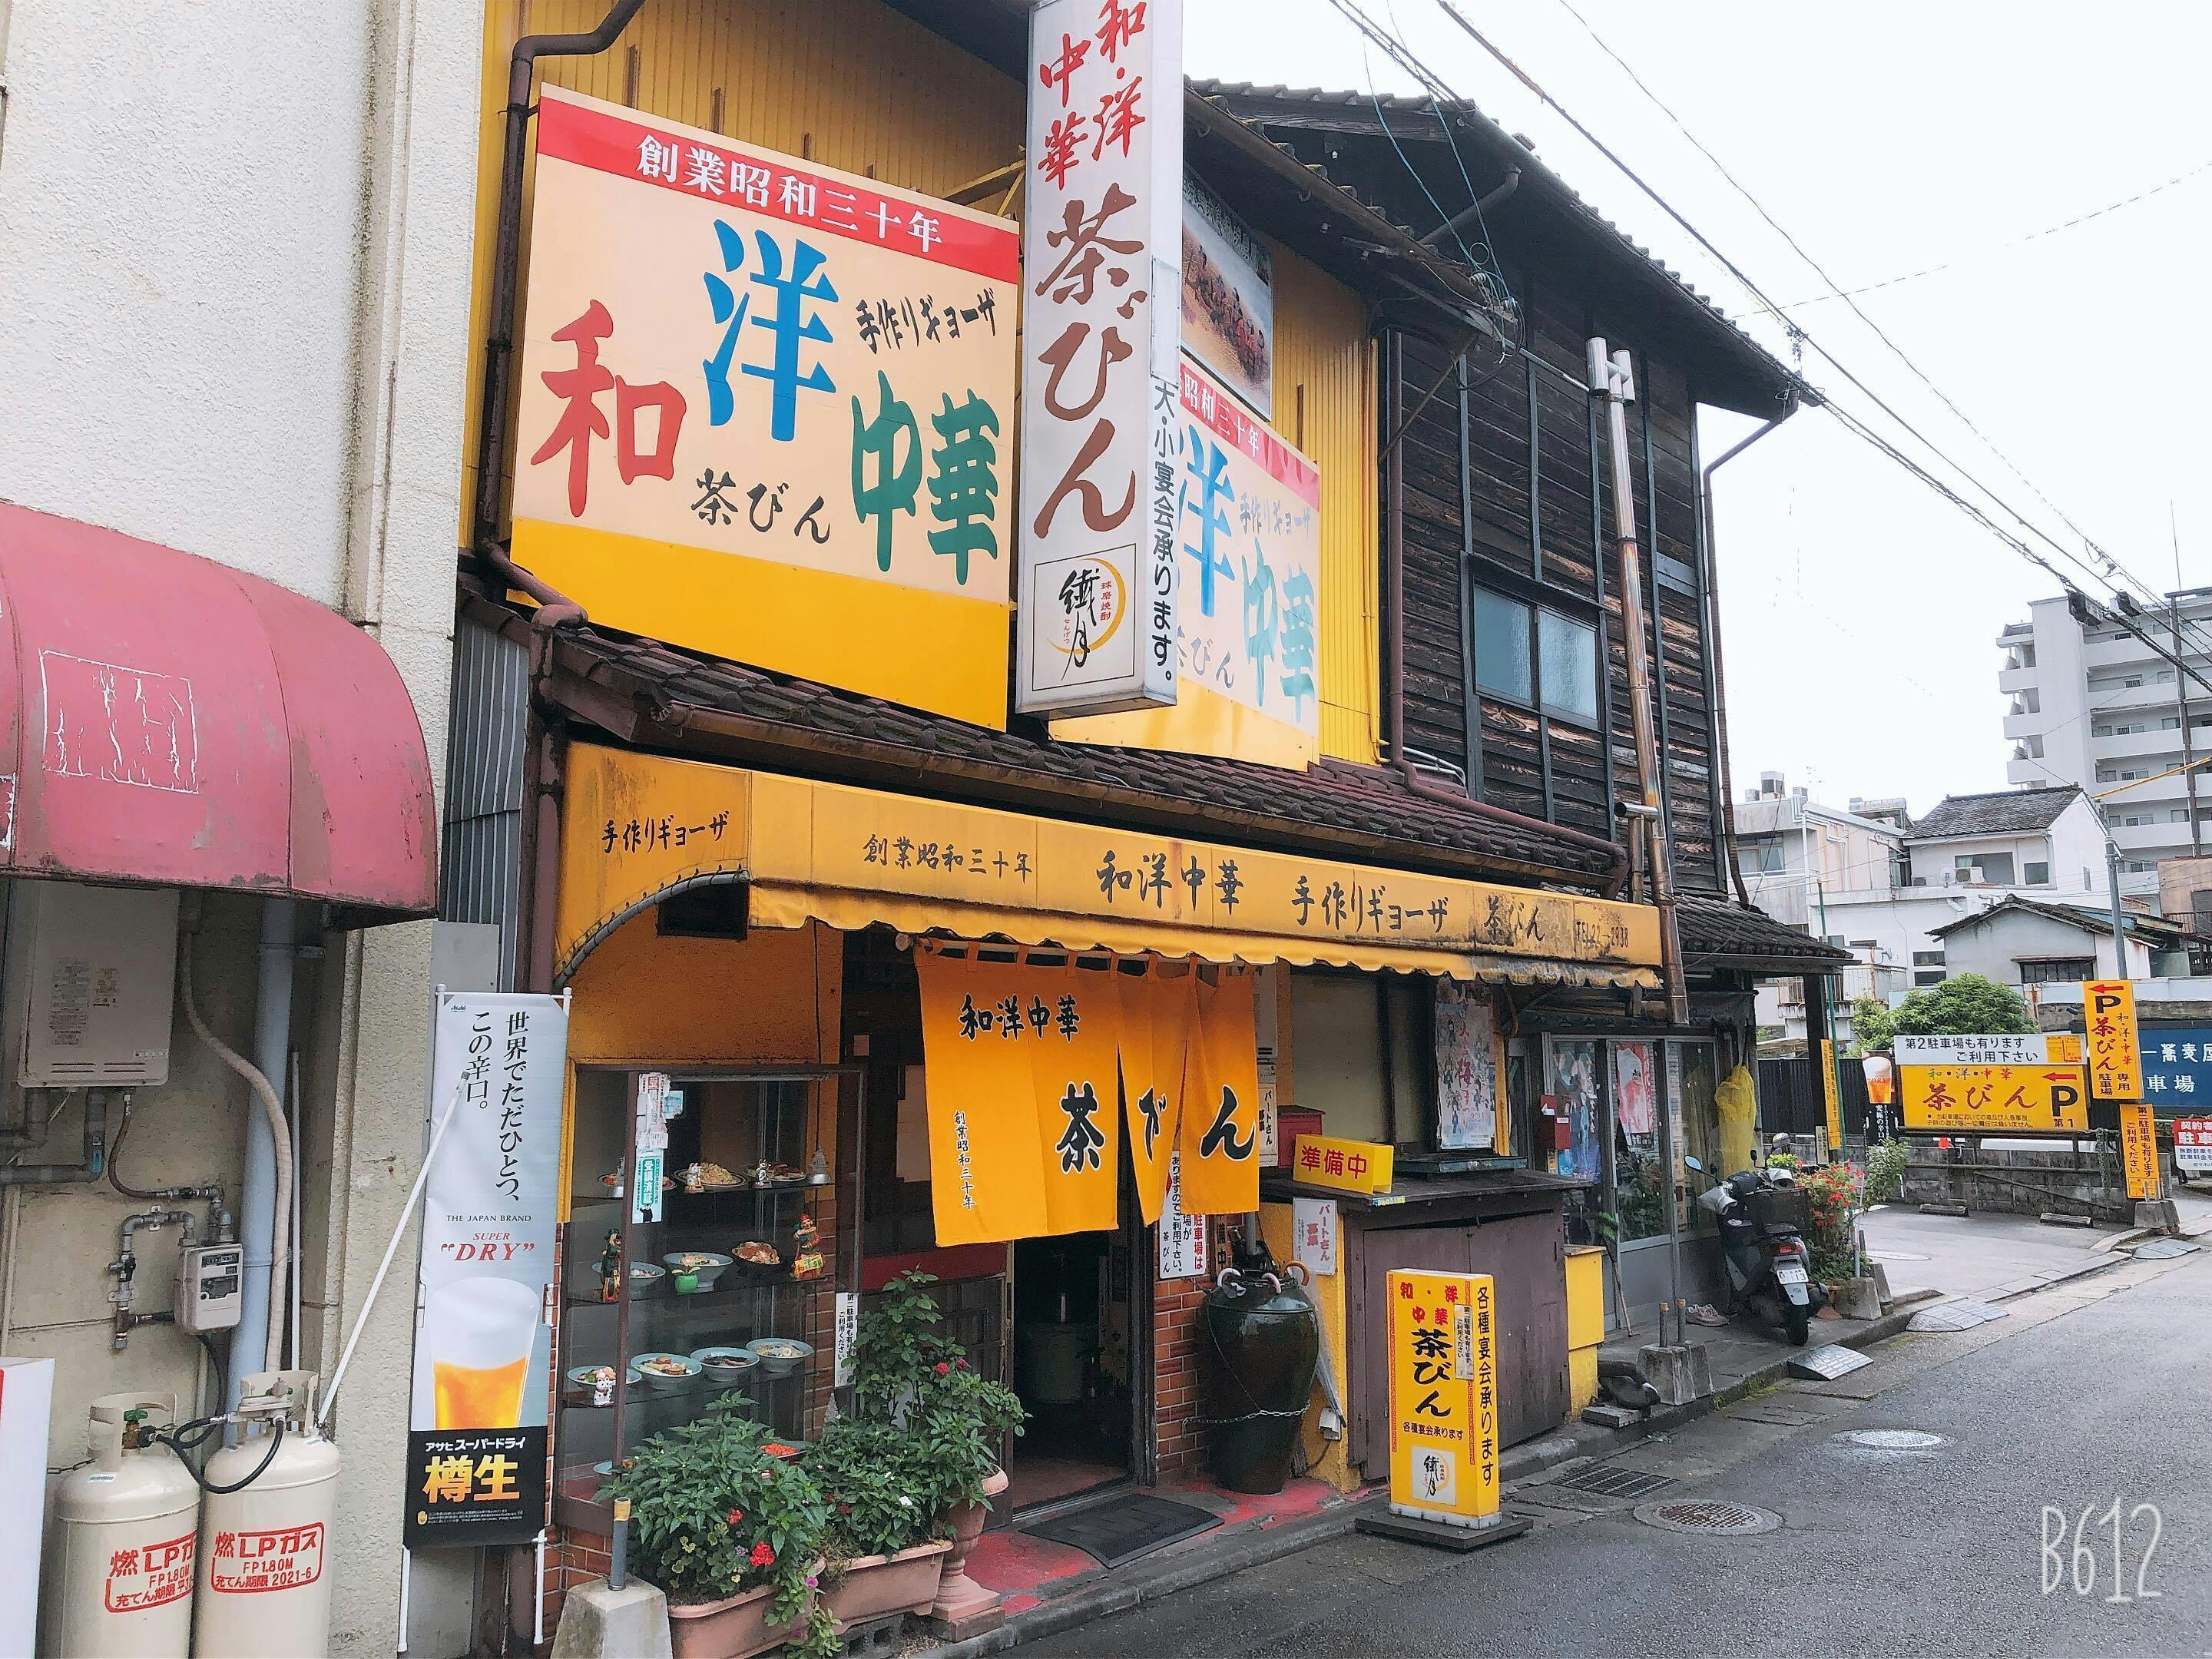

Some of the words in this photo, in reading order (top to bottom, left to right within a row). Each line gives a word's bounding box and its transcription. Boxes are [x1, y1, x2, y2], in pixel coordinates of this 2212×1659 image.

[1038, 33, 1091, 190] 中華
[634, 132, 943, 254] 創業昭和三十年
[856, 287, 996, 355] 手作りギョーザ
[1034, 182, 1147, 539] 茶びん
[530, 299, 687, 518] 和
[1181, 376, 1260, 458] 昭和三十年
[850, 369, 1000, 586] 中華
[690, 467, 832, 545] 茶びん
[1239, 492, 1311, 537] 手作りギョーザ
[1100, 581, 1112, 621] 球磨焼酎
[1242, 537, 1315, 724] 中華
[601, 810, 730, 854] 手作りギョーザ
[863, 833, 1032, 884] 創業昭和三十年
[1096, 850, 1244, 916] 和洋中華
[1292, 875, 1449, 934] 手作りギョーザ
[959, 993, 1081, 1042] 和洋中華
[2095, 995, 2121, 1014] P
[466, 1012, 492, 1110] この辛口。
[1906, 1037, 2025, 1050] 第2駐車場も有ります
[1956, 1051, 2038, 1063] ご利用下さい
[2091, 1016, 2119, 1071] 茶びん
[496, 1011, 530, 1201] 世界でただひとつ、
[1922, 1082, 2038, 1111] 茶びん
[2050, 1084, 2079, 1117] P
[2098, 1073, 2113, 1096] 駐車場
[2054, 1118, 2075, 1128] 第1
[2137, 1107, 2154, 1177] 第二駐車場も有ります
[953, 1111, 976, 1210] 創業昭和三十年
[1300, 1145, 1367, 1180] 準備中
[446, 1214, 464, 1223] THE
[467, 1214, 496, 1223] JAPAN
[472, 1232, 510, 1240] SUPER
[1319, 1204, 1331, 1262] パートさん
[1162, 1231, 1171, 1273] 茶びん
[1411, 1328, 1453, 1417] 茶びん
[1477, 1286, 1494, 1486] 各種宴会承ります
[426, 1437, 526, 1452] アサヒスーパードライ
[1402, 1421, 1464, 1440] 各種宴会承ります
[423, 1454, 520, 1504] 樽生
[239, 1531, 317, 1558] LPガス
[116, 1583, 175, 1607] 充てん期限
[216, 1575, 268, 1588] 充てん期限
[272, 1567, 311, 1585] 2021-6
